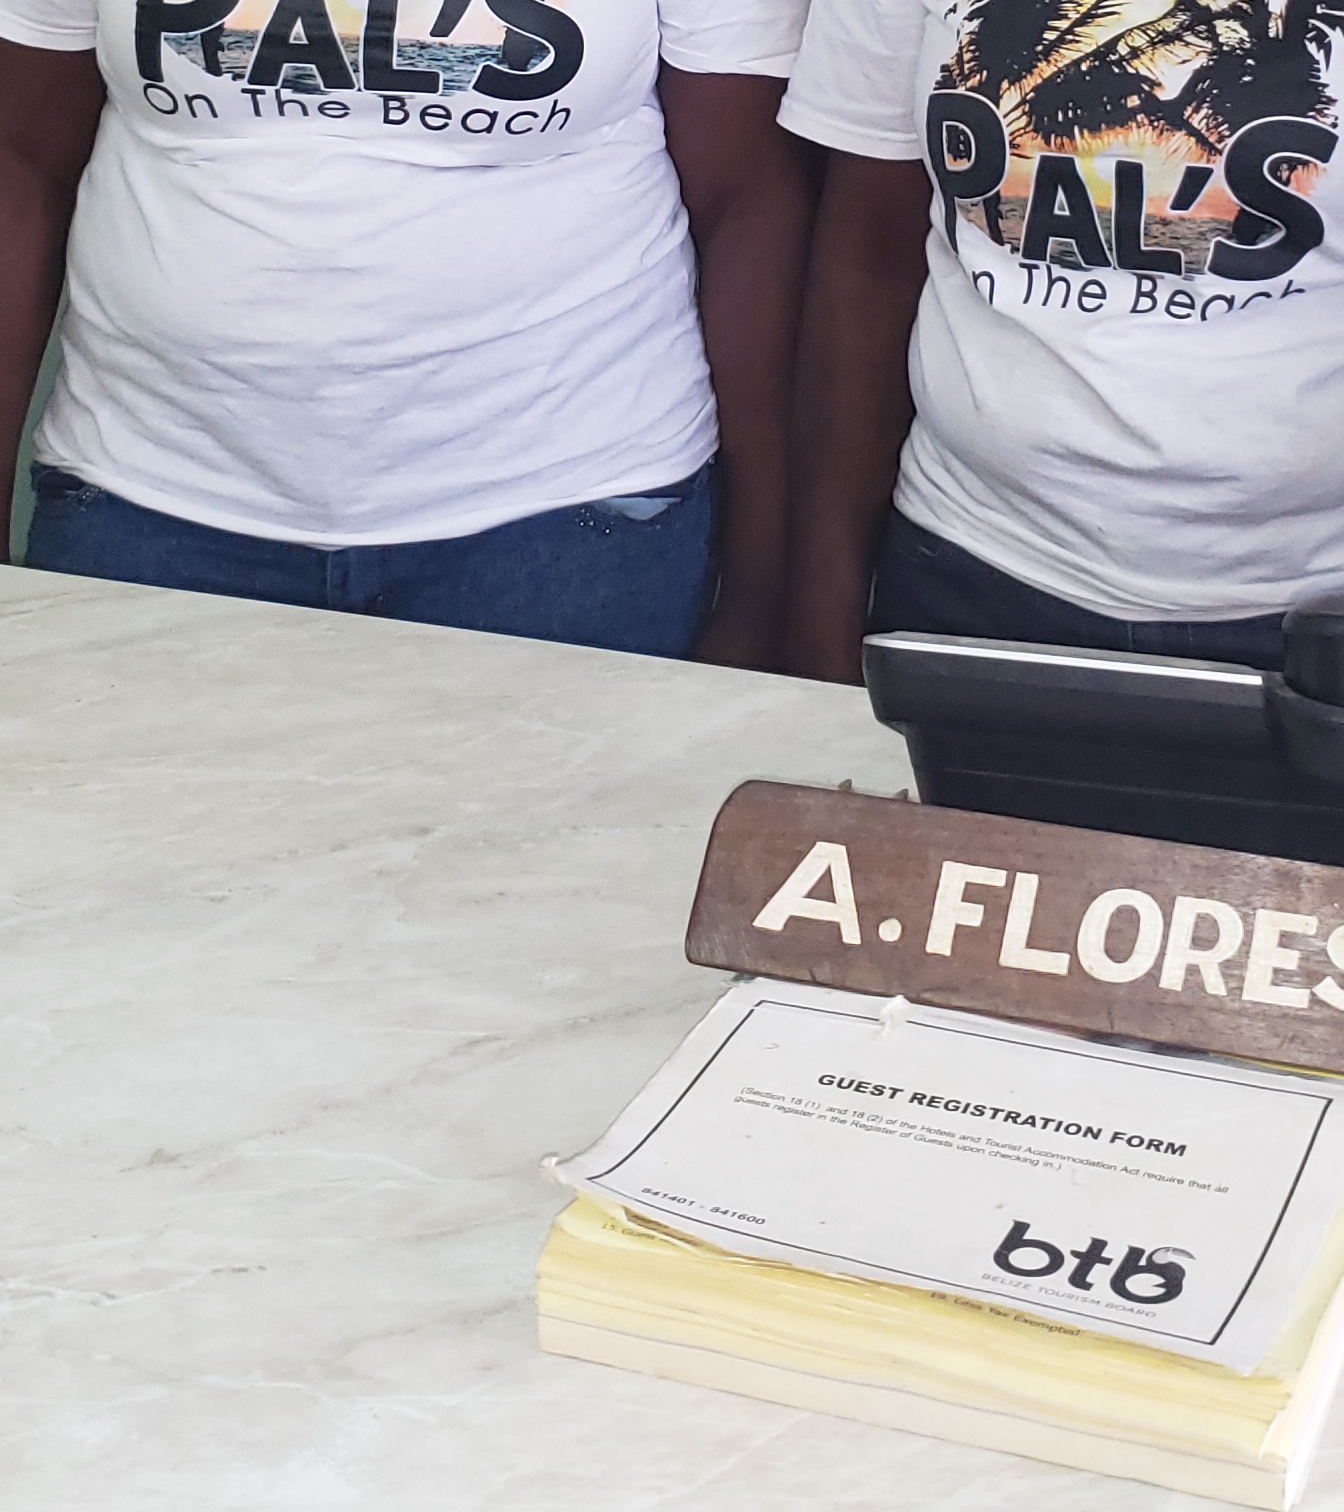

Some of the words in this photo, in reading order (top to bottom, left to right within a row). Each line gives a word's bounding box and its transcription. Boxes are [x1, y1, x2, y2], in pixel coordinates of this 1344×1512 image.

[143, 82, 219, 120] On
[241, 88, 352, 120] The
[382, 95, 572, 136] Beach
[926, 91, 1339, 281] PAL'S
[971, 268, 996, 307] n
[1018, 262, 1109, 314] The
[734, 1095, 770, 1109] guests
[773, 1103, 815, 1118] register
[830, 1115, 847, 1125] the
[849, 1119, 897, 1137] Register
[899, 1130, 913, 1139] of
[914, 1134, 953, 1148] Guests
[956, 1144, 985, 1155] upon
[988, 1149, 1040, 1166] checking
[740, 1086, 785, 1102] (Section
[790, 1097, 803, 1106] 18
[804, 1099, 821, 1110] (1)
[825, 1106, 848, 1116] and
[851, 1110, 865, 1119] 18
[867, 1113, 883, 1124] (2)
[885, 1118, 898, 1126] of
[900, 1121, 917, 1130] the
[920, 1125, 956, 1139] Hotels
[958, 1134, 981, 1143] and
[984, 1138, 1022, 1152] Tourist
[1023, 1146, 1118, 1172] Accommodation
[1120, 1165, 1140, 1176] Act
[1142, 1170, 1184, 1186] require
[1188, 1180, 1211, 1191] that
[1214, 1184, 1229, 1194] all
[818, 1074, 903, 1100] GUEST
[908, 1092, 1103, 1140] REGISTRATION
[1109, 1132, 1188, 1157] FORM
[641, 1187, 696, 1207] 841401
[709, 1204, 766, 1226] 841600
[980, 1272, 1032, 1290] BELIZE
[1038, 1286, 1102, 1306] TOURISM
[1105, 1302, 1157, 1318] BOARD
